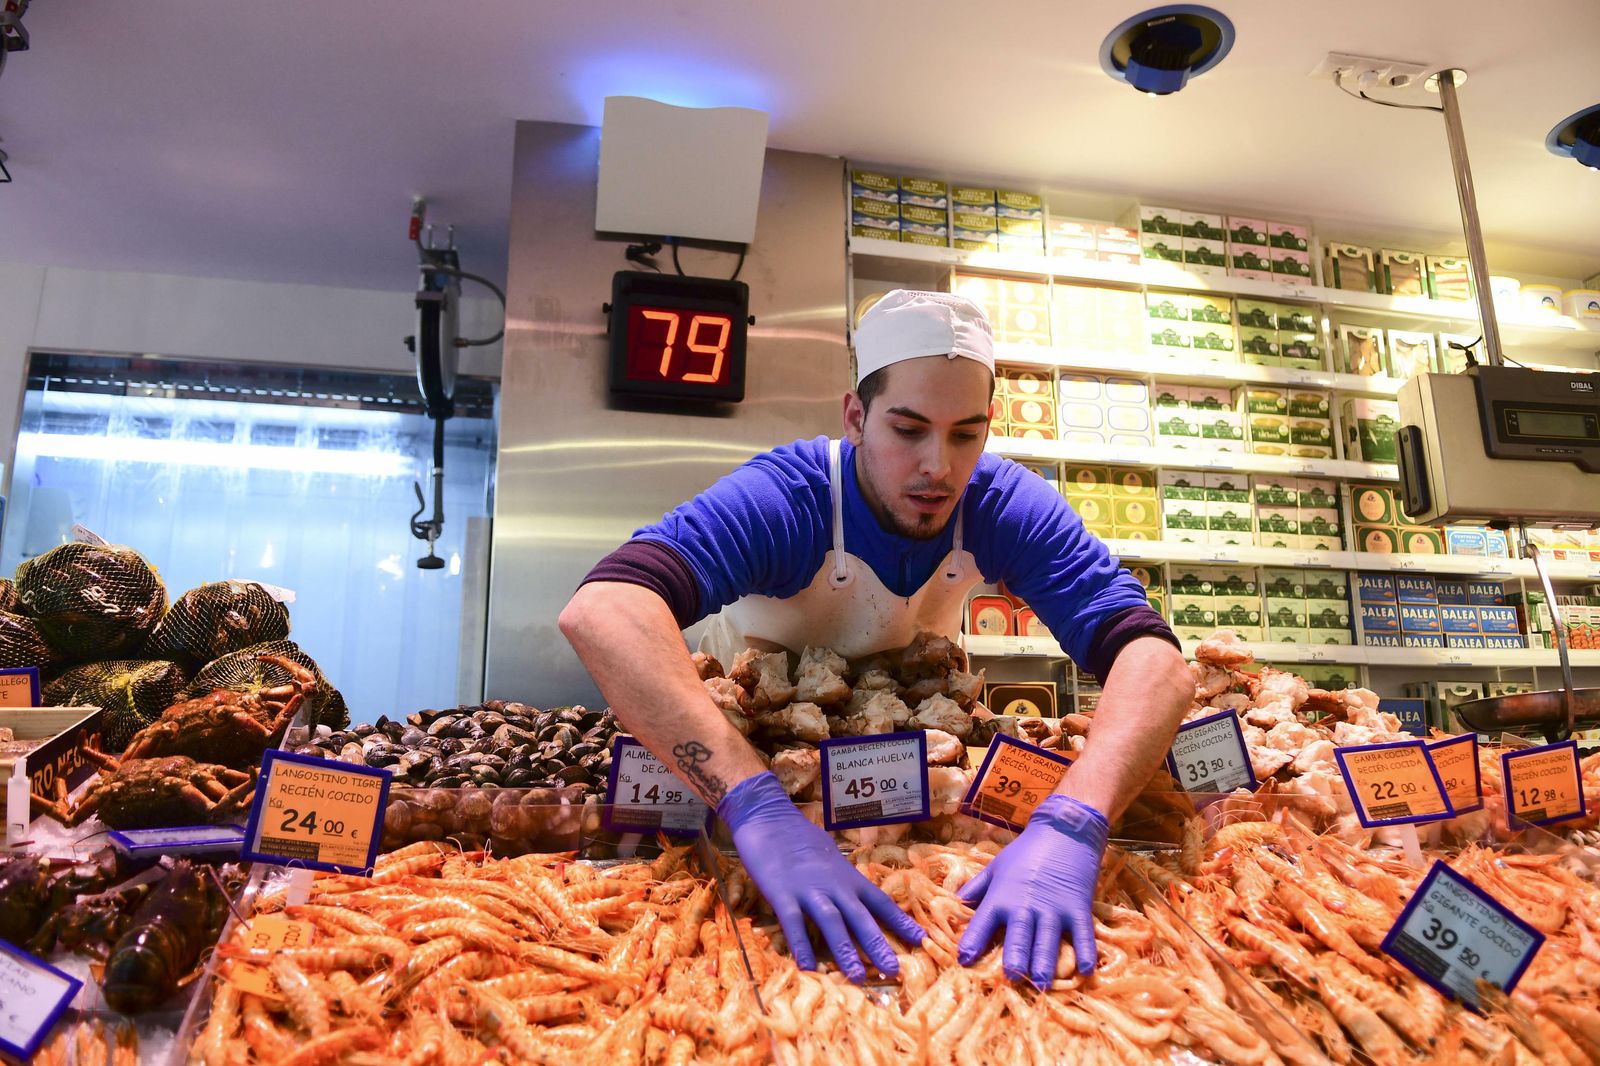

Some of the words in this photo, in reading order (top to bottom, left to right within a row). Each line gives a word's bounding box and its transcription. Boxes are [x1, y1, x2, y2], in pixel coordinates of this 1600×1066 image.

[641, 310, 731, 383] 79
[1570, 382, 1593, 391] DIBAL
[1358, 578, 1392, 589] BALEA
[1399, 579, 1433, 590] BALEA
[1437, 585, 1464, 595] ALEA
[1469, 585, 1502, 595] BALEA
[1361, 606, 1396, 618] BALEA
[1402, 607, 1437, 619] BALEA
[1441, 609, 1476, 620] BALEA
[1481, 610, 1515, 620] BALEA
[1365, 635, 1399, 647] BALEA
[1405, 637, 1441, 649] BALEA
[1450, 638, 1483, 648] BALEA
[1487, 638, 1520, 648] BALEA
[1382, 710, 1421, 722] ALEA
[1194, 719, 1231, 739] GIGANTES
[830, 747, 857, 757] GAMBA
[887, 739, 916, 748] COCIDA
[1174, 742, 1201, 757] RECIÉN
[1201, 731, 1233, 748] COCIDAS
[1007, 745, 1032, 761] PATAS
[1354, 752, 1382, 764] GAMBA
[1384, 748, 1416, 760] COCIDA
[836, 758, 874, 771] BLANCA
[876, 751, 915, 765] HUELVA
[1000, 755, 1031, 773] RECIÉN
[1390, 760, 1423, 770] COCIDA
[1438, 752, 1471, 768] COCIDOS
[641, 764, 655, 773] DE
[657, 765, 672, 774] CA
[1540, 766, 1568, 777] COCIDO
[275, 767, 348, 785] LANGOSTINO
[352, 777, 382, 790] TIGRE
[903, 782, 909, 790] €
[994, 776, 1022, 797] 39
[1370, 781, 1399, 800] 22
[279, 783, 325, 799] RECIÉN
[327, 790, 374, 805] COCIDO
[351, 829, 359, 839] €
[1436, 875, 1499, 924] LANGOSTINO
[1503, 920, 1531, 947] TIGRE
[1430, 890, 1480, 928] GIGANTE
[1479, 926, 1522, 958] COCIDO
[1481, 970, 1490, 978] €
